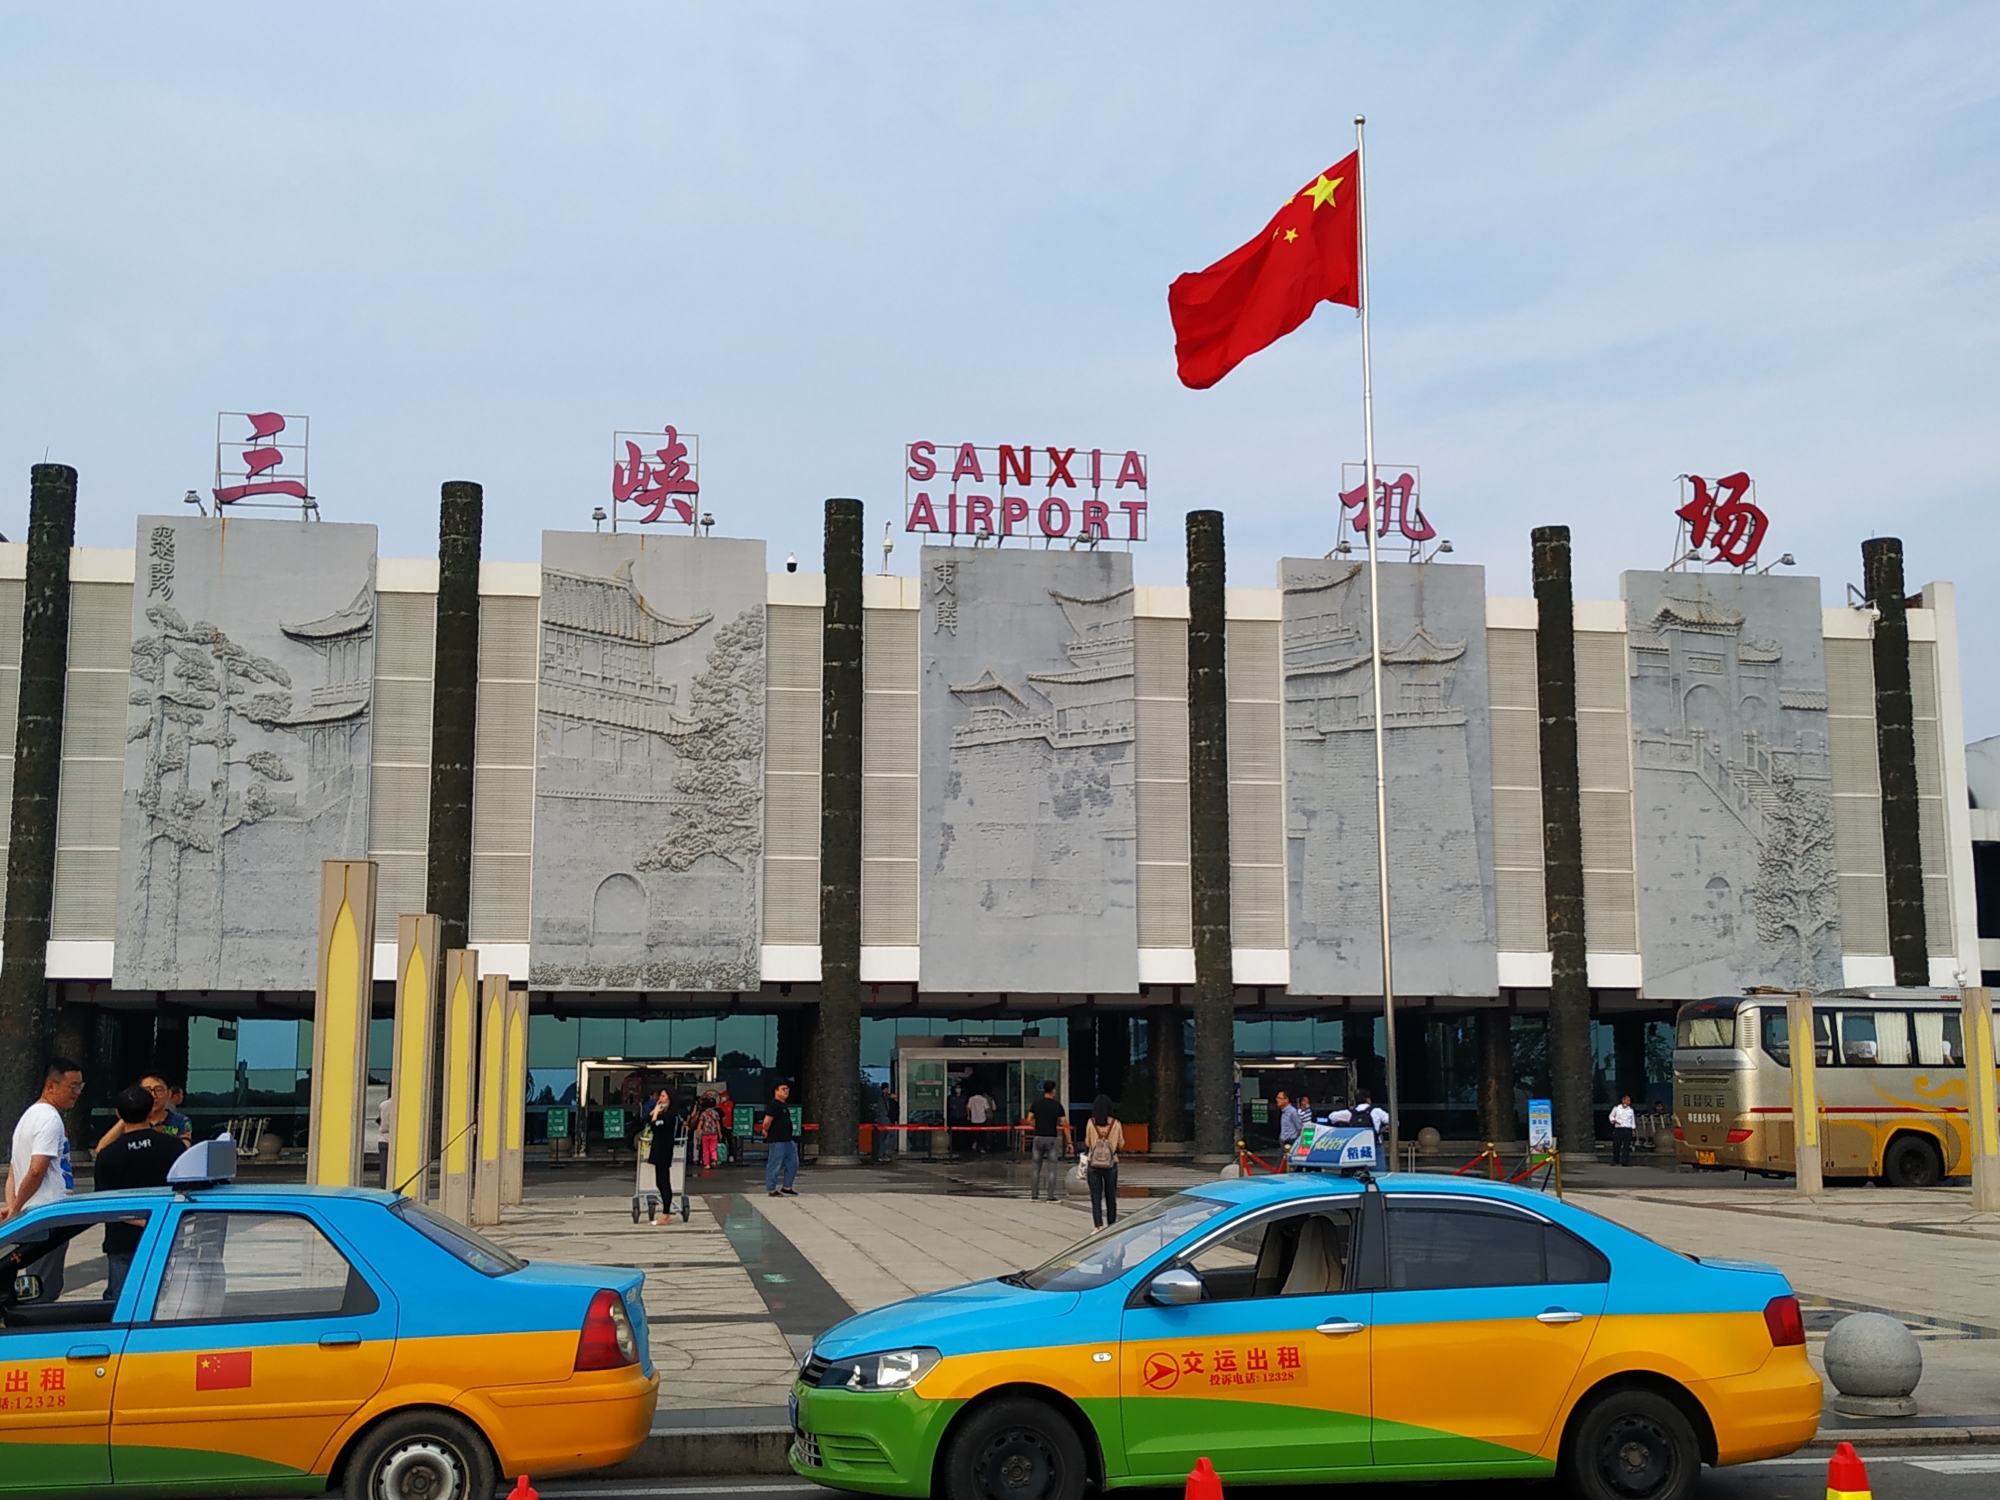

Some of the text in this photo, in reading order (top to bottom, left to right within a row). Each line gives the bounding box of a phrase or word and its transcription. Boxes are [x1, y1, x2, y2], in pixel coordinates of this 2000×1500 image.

[907, 440, 1148, 490] SANXIA
[212, 411, 1769, 567] 三 峡 机 场
[905, 492, 1148, 541] AIRPORT
[1683, 1094, 1725, 1108] 宜昌交运
[4, 1366, 67, 1393] 出租
[1181, 1345, 1302, 1375] 交运出租
